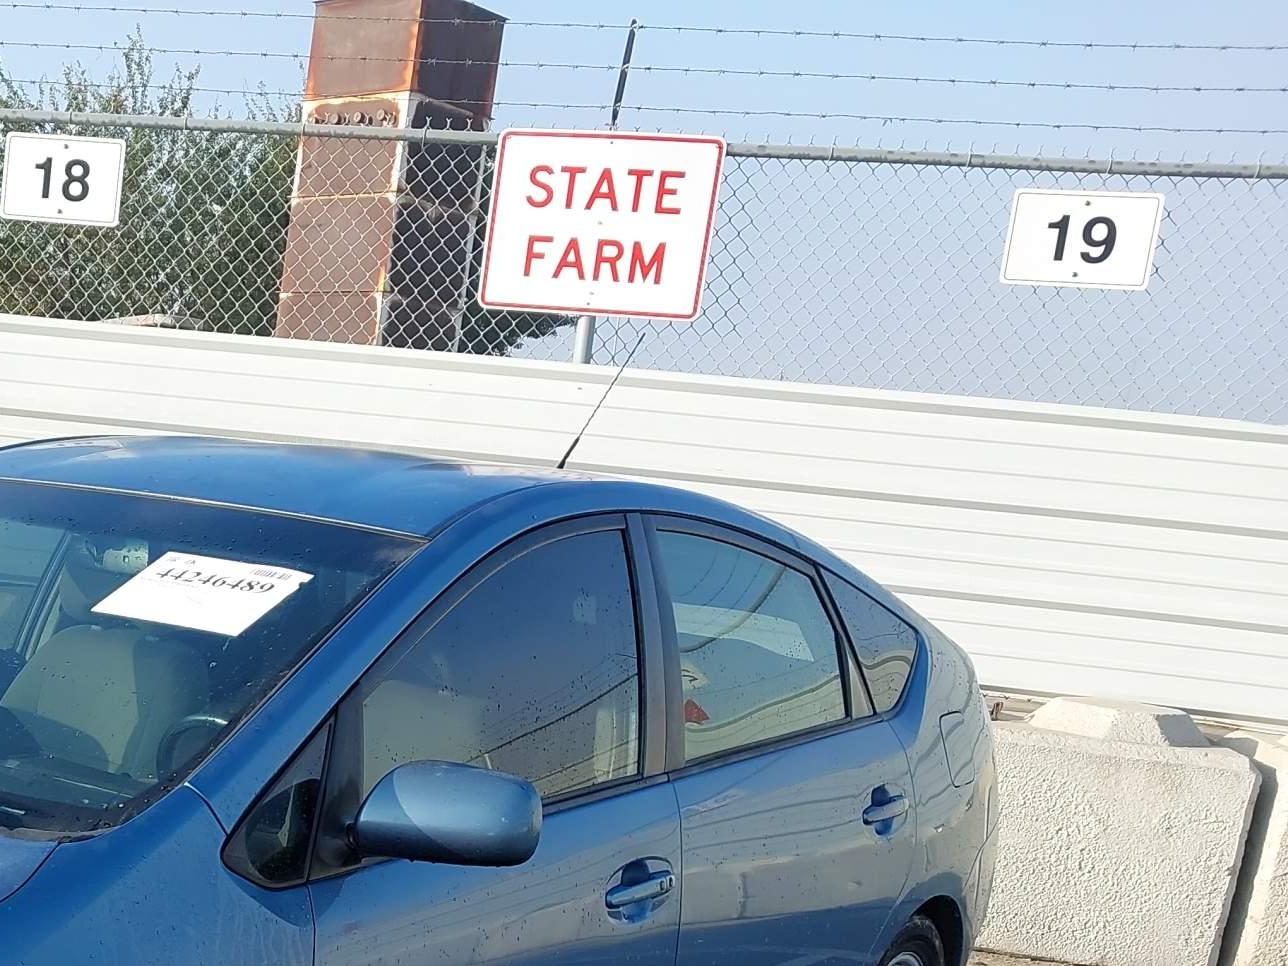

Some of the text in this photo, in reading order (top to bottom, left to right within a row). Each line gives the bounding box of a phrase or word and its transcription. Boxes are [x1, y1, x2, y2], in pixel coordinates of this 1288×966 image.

[35, 157, 90, 202] 18
[527, 165, 685, 215] STATE
[524, 235, 666, 284] FARM
[1047, 214, 1117, 264] 19
[155, 567, 275, 594] 44246489
